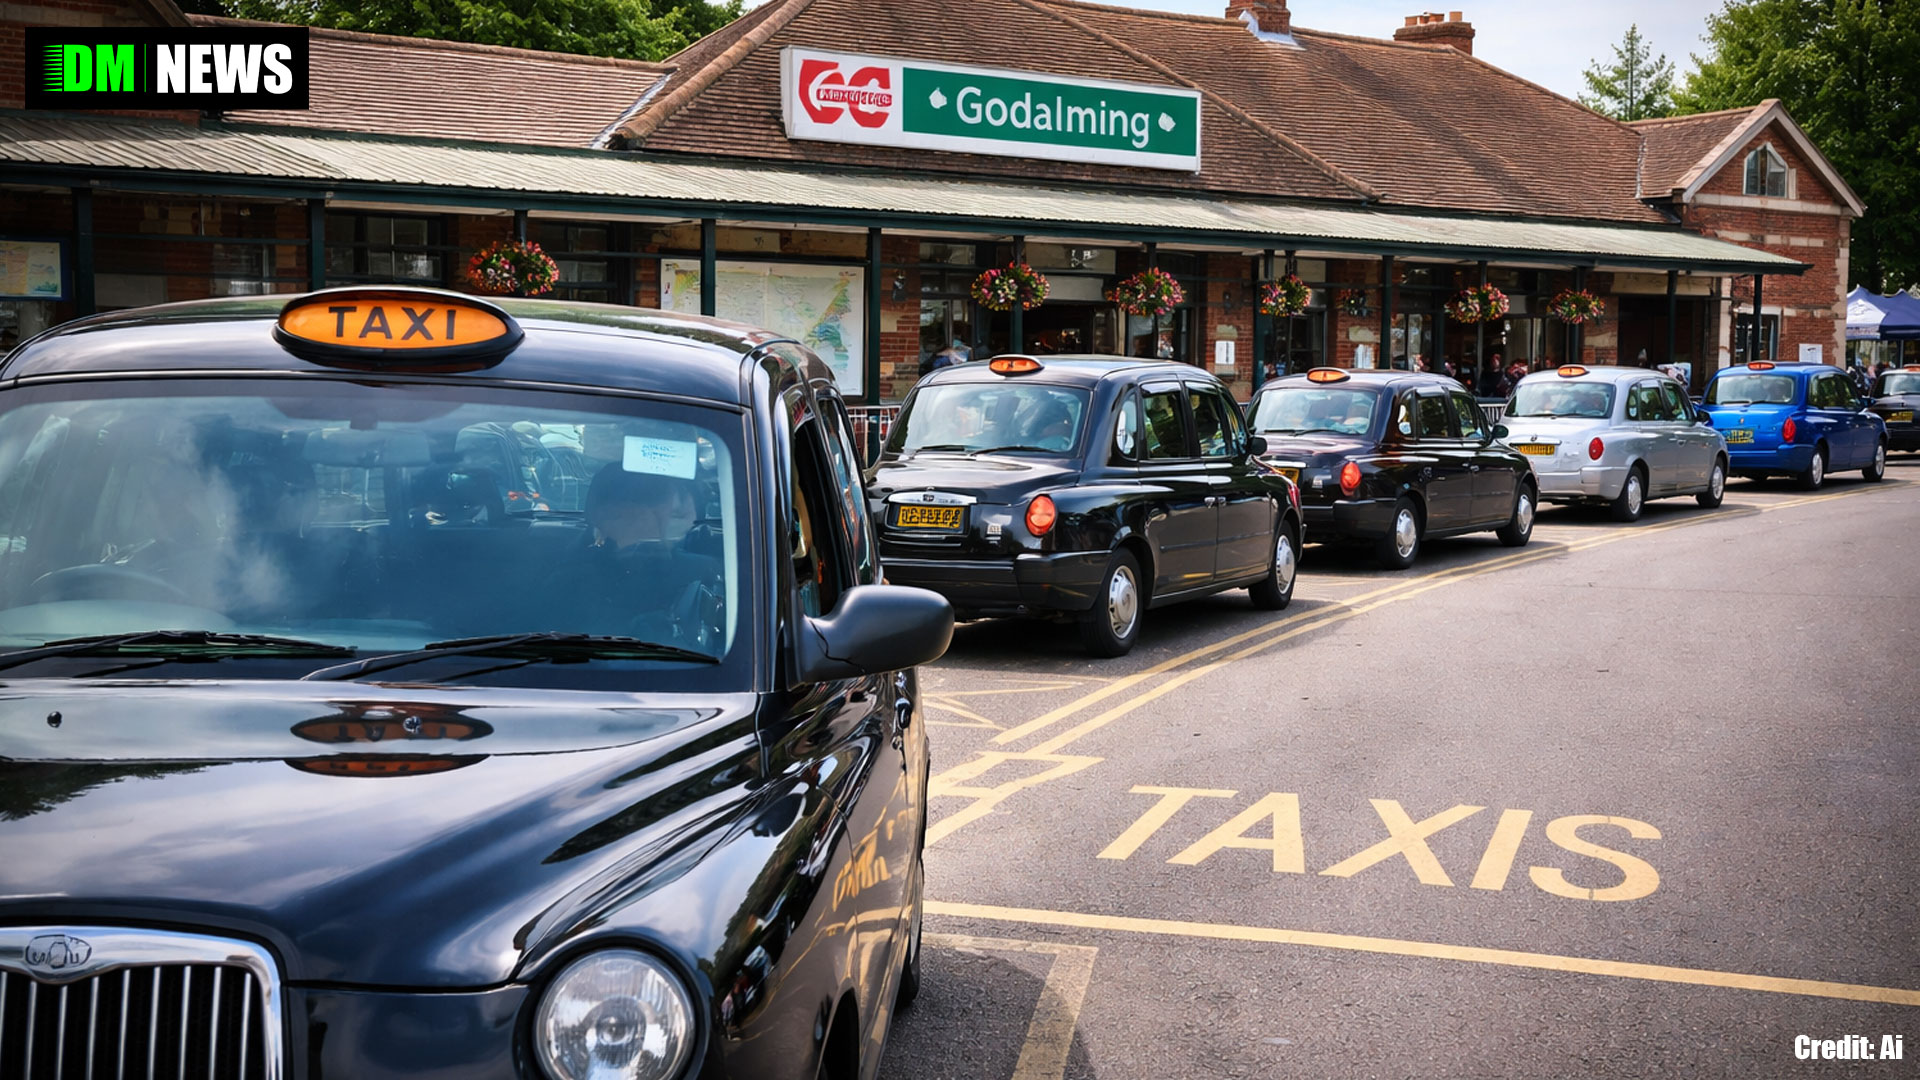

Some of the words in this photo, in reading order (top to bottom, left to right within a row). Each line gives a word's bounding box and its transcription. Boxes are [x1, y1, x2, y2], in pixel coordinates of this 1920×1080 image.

[956, 86, 1150, 149] Godalming
[328, 305, 456, 341] TAXI
[1097, 785, 1661, 902] TAXIS
